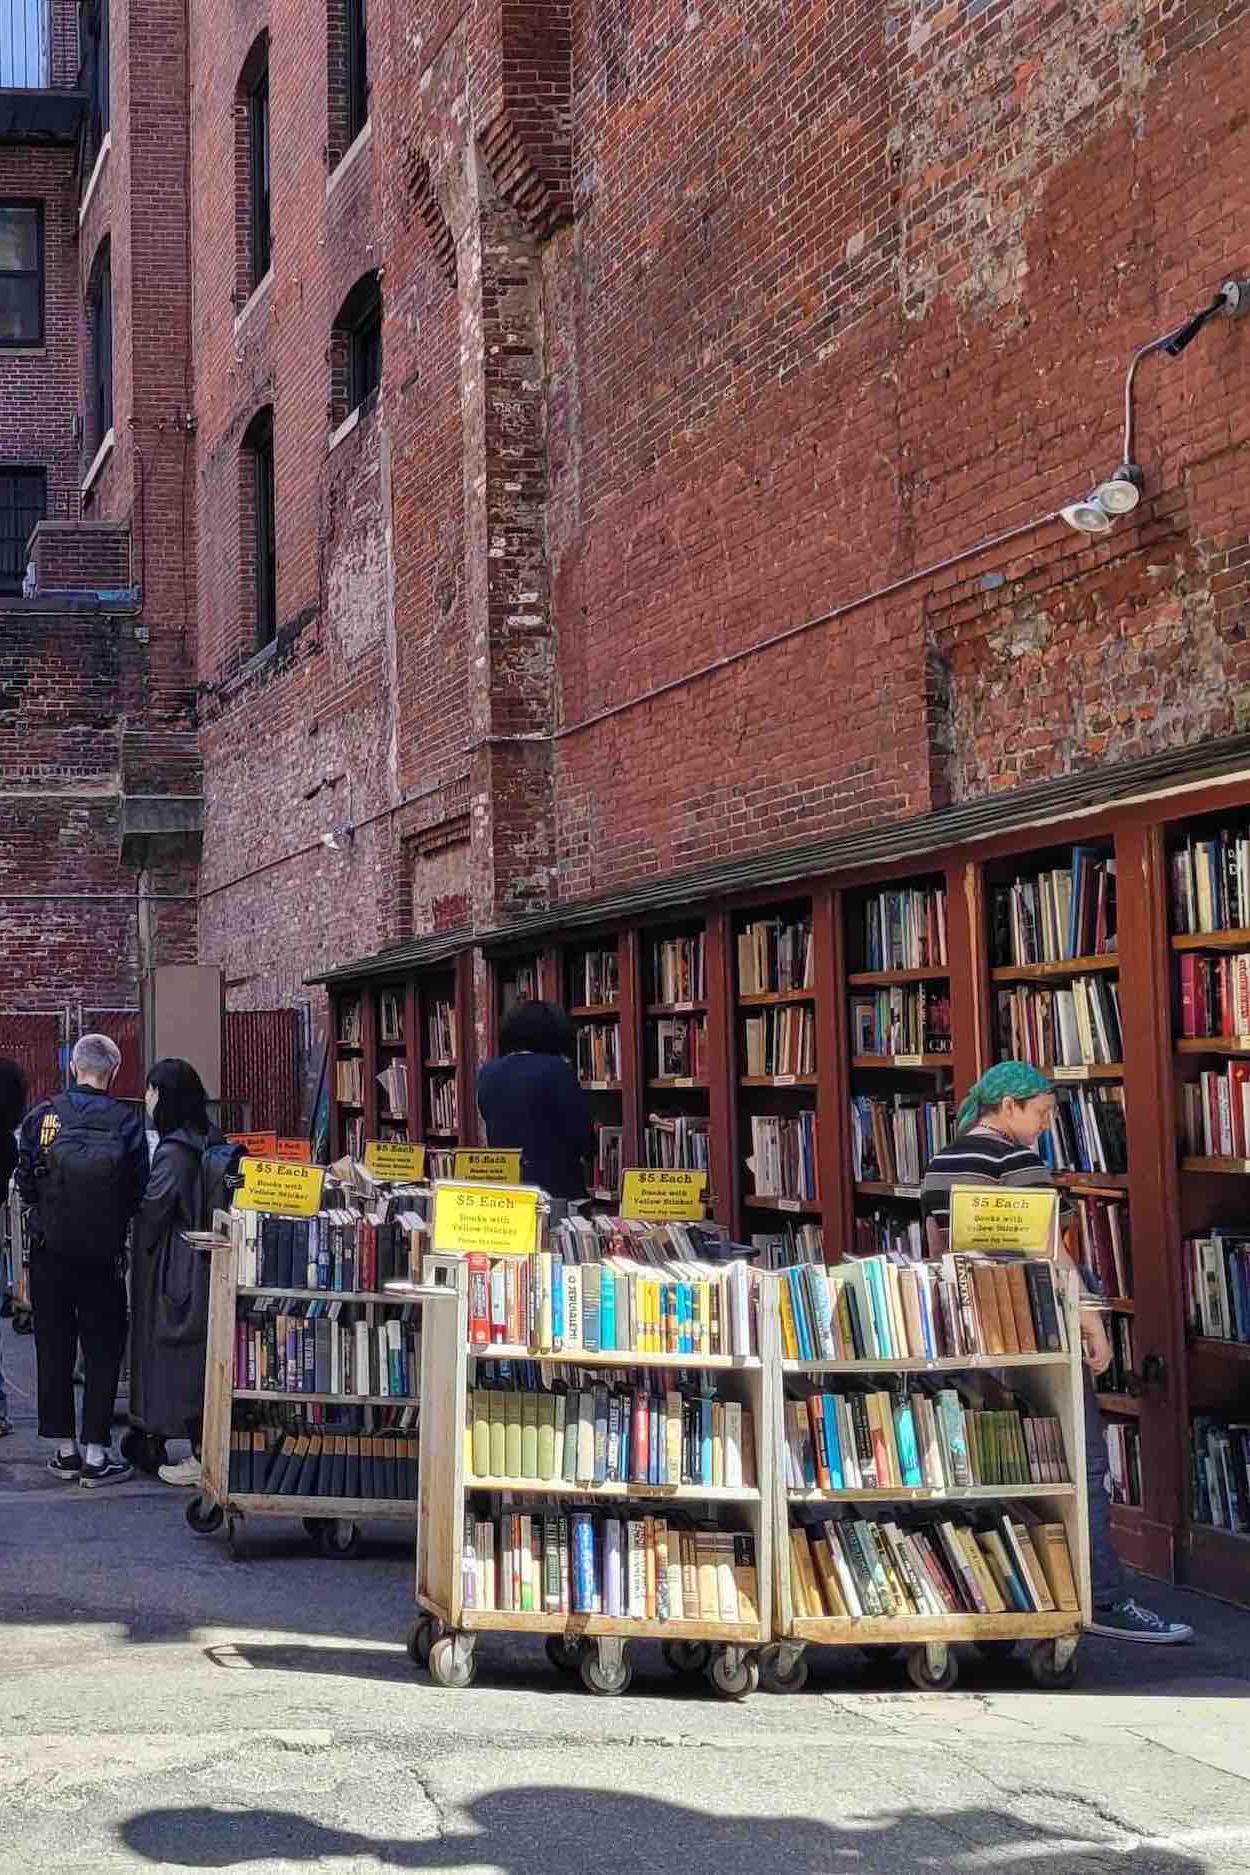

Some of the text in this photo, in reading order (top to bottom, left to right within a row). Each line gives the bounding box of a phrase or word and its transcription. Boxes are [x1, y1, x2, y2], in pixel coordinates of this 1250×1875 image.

[254, 1162, 309, 1177] $5 Each
[638, 1172, 692, 1184] $5 Each
[456, 1194, 516, 1208] $5 Each
[972, 1197, 1030, 1208] $5 Each
